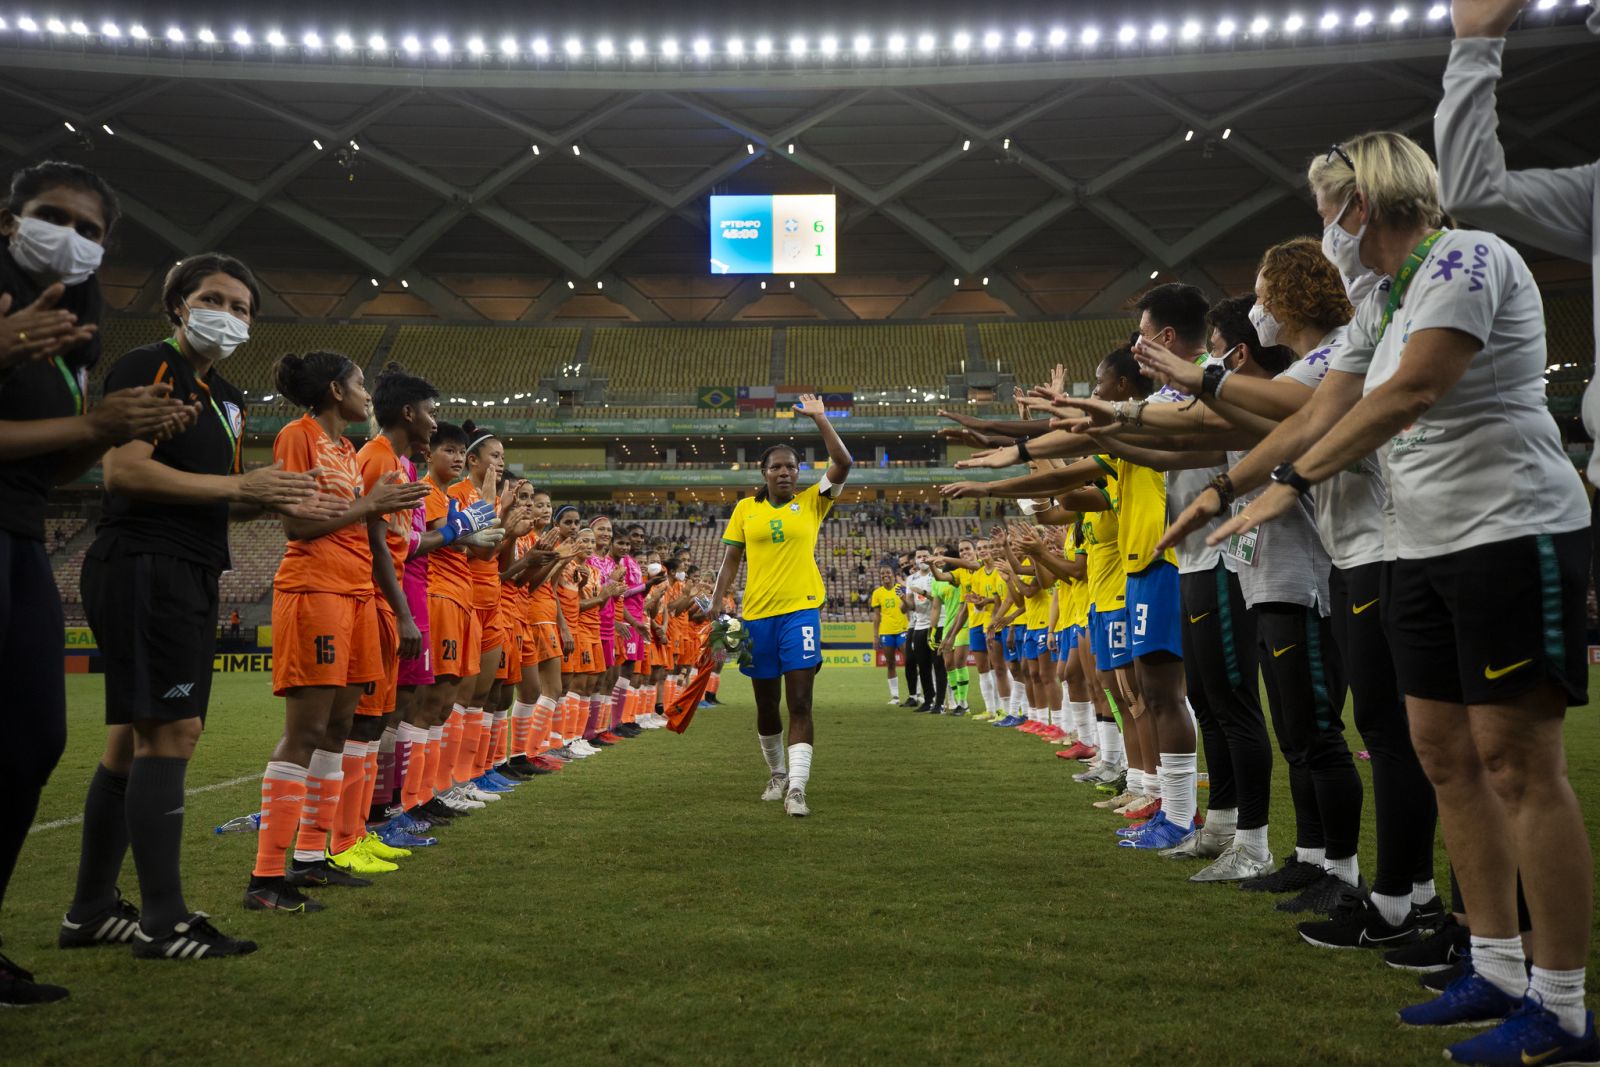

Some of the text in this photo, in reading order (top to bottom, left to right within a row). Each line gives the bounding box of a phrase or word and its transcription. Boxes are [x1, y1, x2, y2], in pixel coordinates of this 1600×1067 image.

[813, 220, 824, 232] 6
[815, 244, 822, 256] 1
[1464, 244, 1489, 292] vivo
[769, 519, 785, 544] 8
[1134, 603, 1148, 636] 3
[802, 626, 815, 651] 8
[1109, 621, 1126, 648] 13
[314, 635, 335, 664] 15
[424, 648, 430, 671] 1
[834, 655, 858, 664] BOLA
